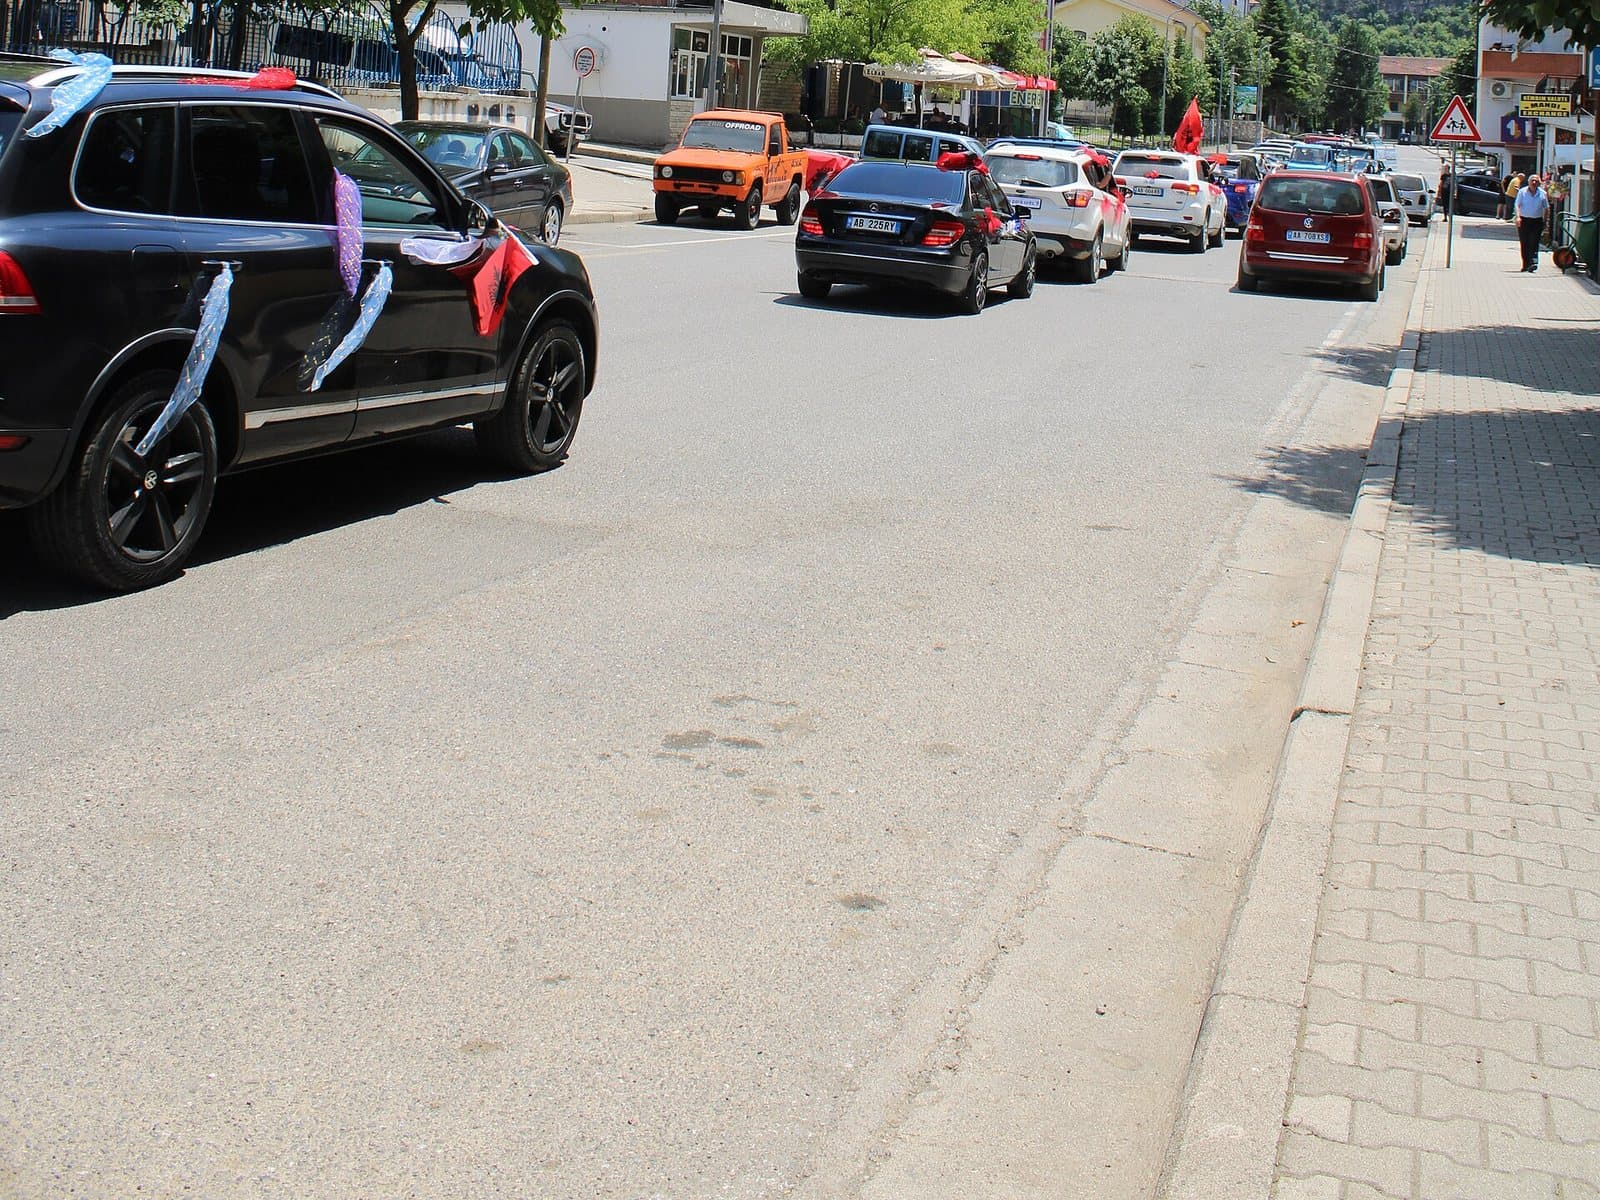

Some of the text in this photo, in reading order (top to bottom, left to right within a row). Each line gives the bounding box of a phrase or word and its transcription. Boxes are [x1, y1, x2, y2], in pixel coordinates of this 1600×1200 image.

[724, 121, 761, 131] OFFROAD
[853, 218, 896, 231] AB 225RY
